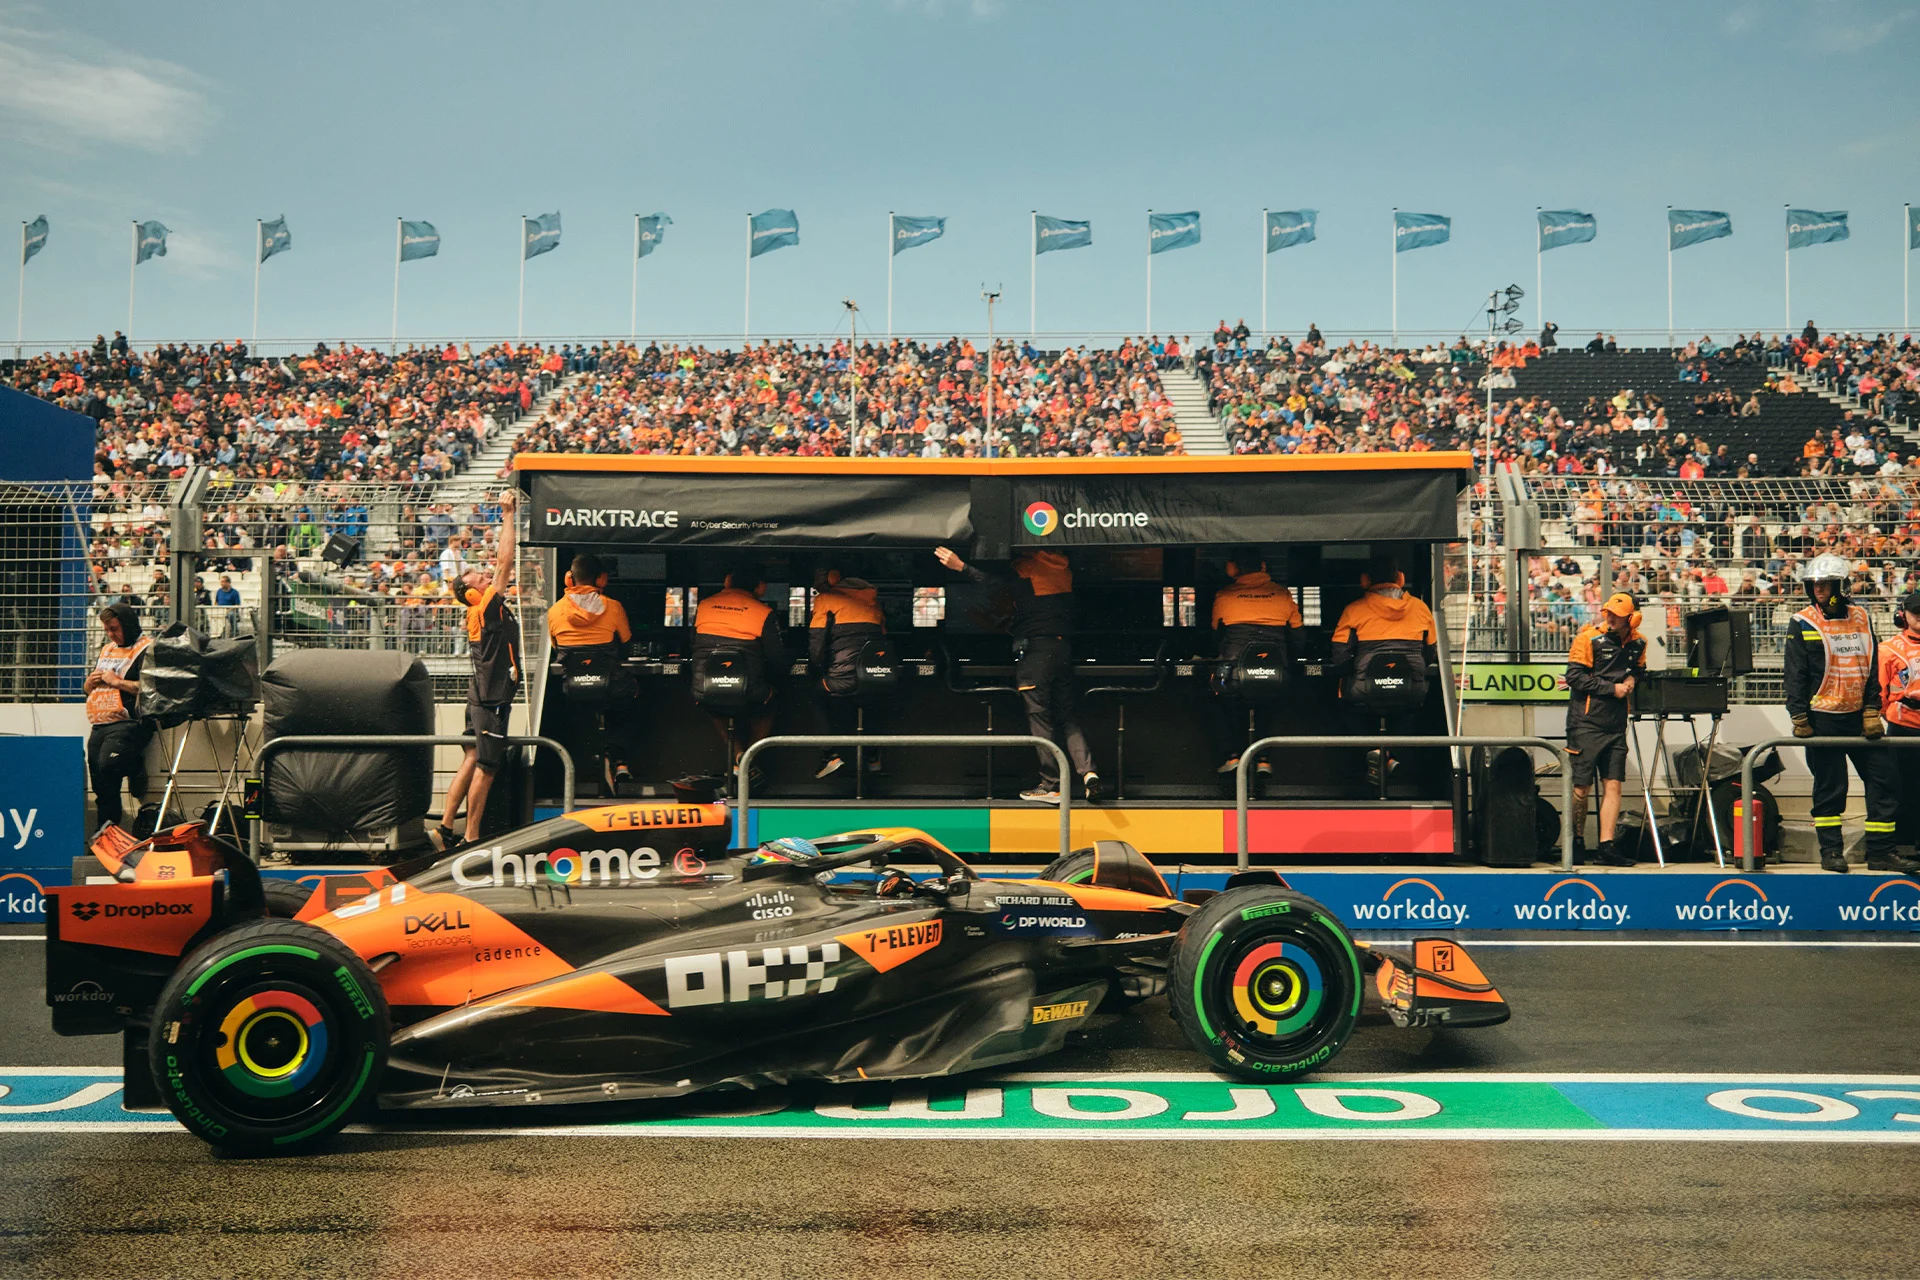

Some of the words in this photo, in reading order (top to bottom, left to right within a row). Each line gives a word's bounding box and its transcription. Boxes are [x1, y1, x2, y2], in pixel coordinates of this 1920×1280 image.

[546, 508, 678, 528] DARKTRACE
[1063, 506, 1148, 529] chrome
[700, 521, 721, 530] Cyber
[722, 521, 751, 530] Security
[865, 665, 892, 674] webex
[1247, 666, 1275, 676] webex
[573, 674, 601, 682] webex
[711, 675, 740, 684] webex
[1374, 676, 1404, 686] webex
[1469, 674, 1556, 692] LANDO
[994, 896, 1040, 905] RICHARD
[1042, 897, 1074, 906] MILLE
[105, 902, 193, 918] Dropbox
[1240, 901, 1291, 921] PIRELLI
[1838, 900, 1920, 921] workd
[404, 911, 470, 935] DELL
[1018, 917, 1039, 927] DP
[1039, 917, 1086, 928] WORLD
[405, 935, 472, 949] Technologies
[664, 942, 840, 1008] OKX
[54, 990, 115, 1003] workday
[333, 965, 375, 1019] PIRELLI
